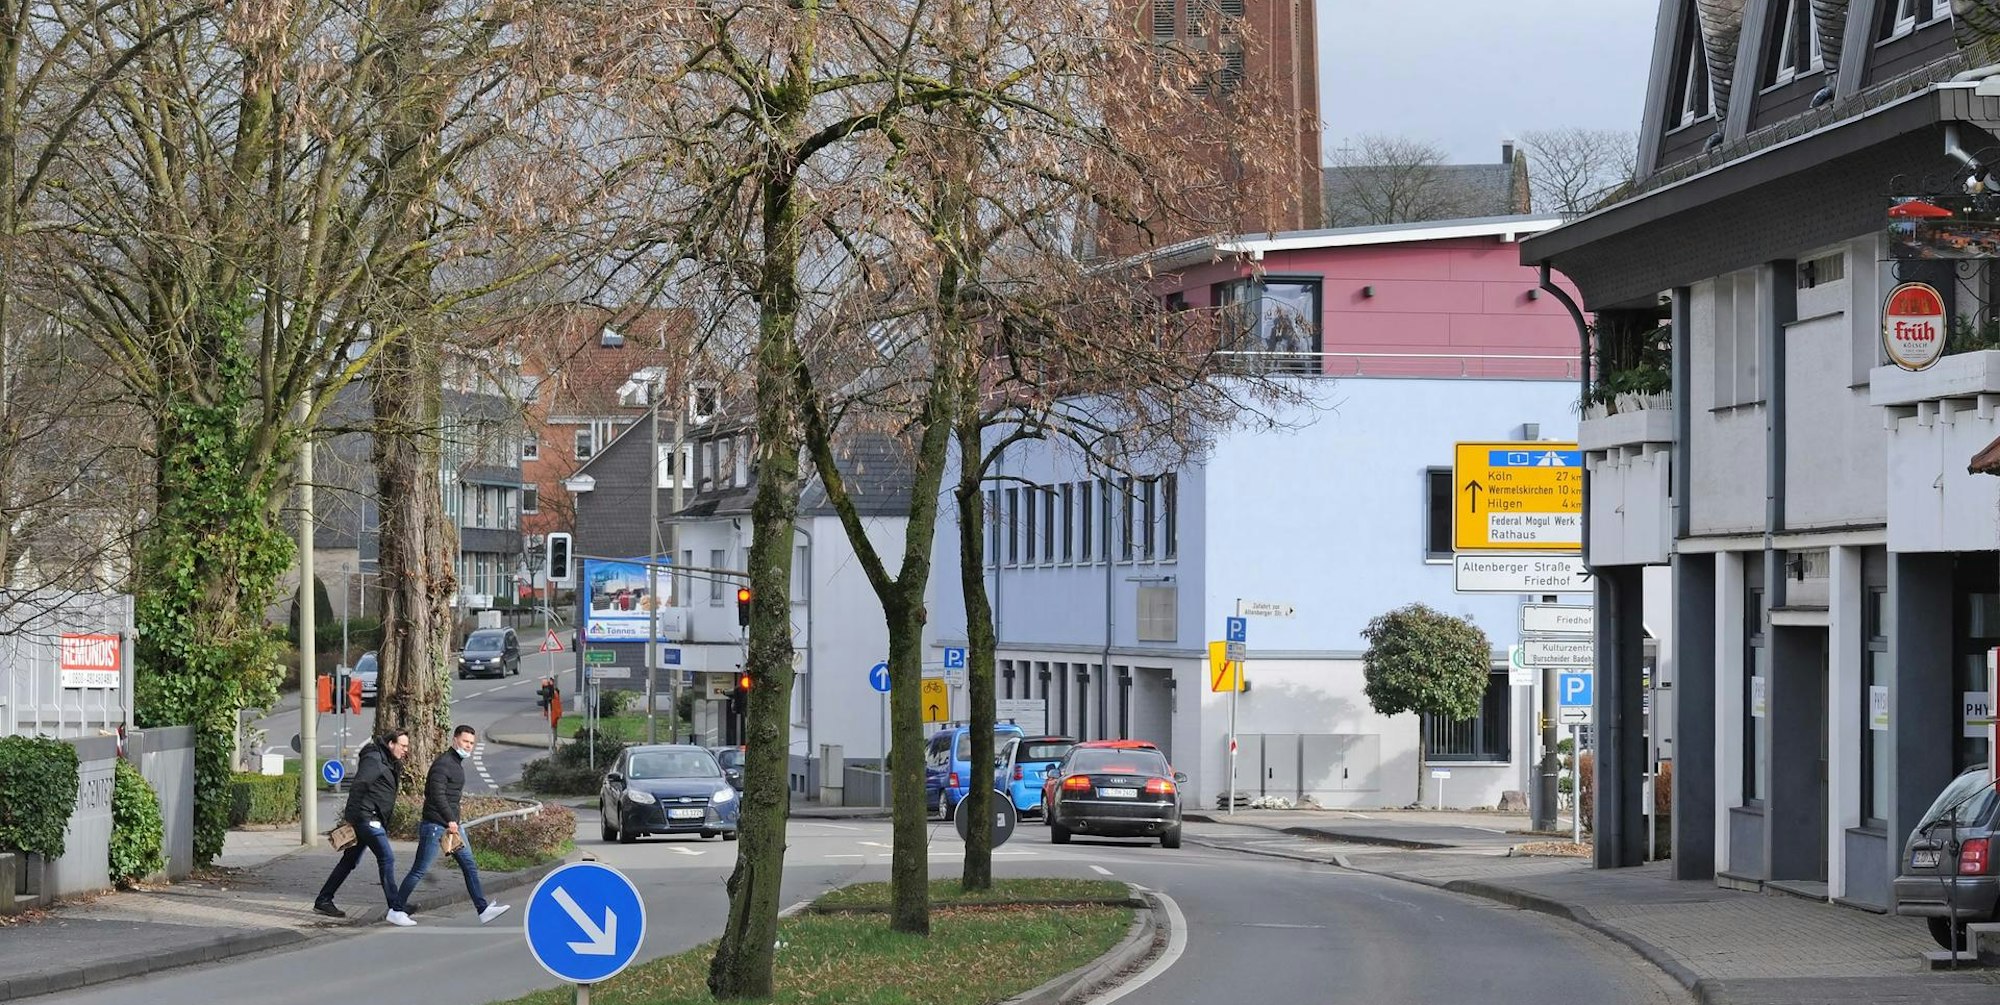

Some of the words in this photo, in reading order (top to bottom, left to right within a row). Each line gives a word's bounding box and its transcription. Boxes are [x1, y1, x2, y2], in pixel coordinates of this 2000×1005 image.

[1894, 320, 1936, 343] früh
[1488, 471, 1512, 481] Köln
[1556, 471, 1568, 481] 27
[1489, 485, 1553, 495] Wermelskirchen
[1558, 485, 1568, 495] 10
[1488, 498, 1522, 510] Hilgen
[1562, 499, 1568, 508] 4
[1491, 516, 1522, 526] Federal
[1526, 516, 1550, 528] Mogul
[1554, 516, 1575, 526] Werk
[1491, 530, 1536, 540] Rathaus
[1463, 562, 1528, 574] Altenberger
[1535, 562, 1571, 572] Straße
[1524, 576, 1570, 586] Friedhof
[1556, 616, 1592, 624] Friedhof
[1230, 619, 1242, 639] P
[948, 650, 960, 666] P
[1532, 654, 1570, 662] Burscheider
[1567, 677, 1585, 702] P
